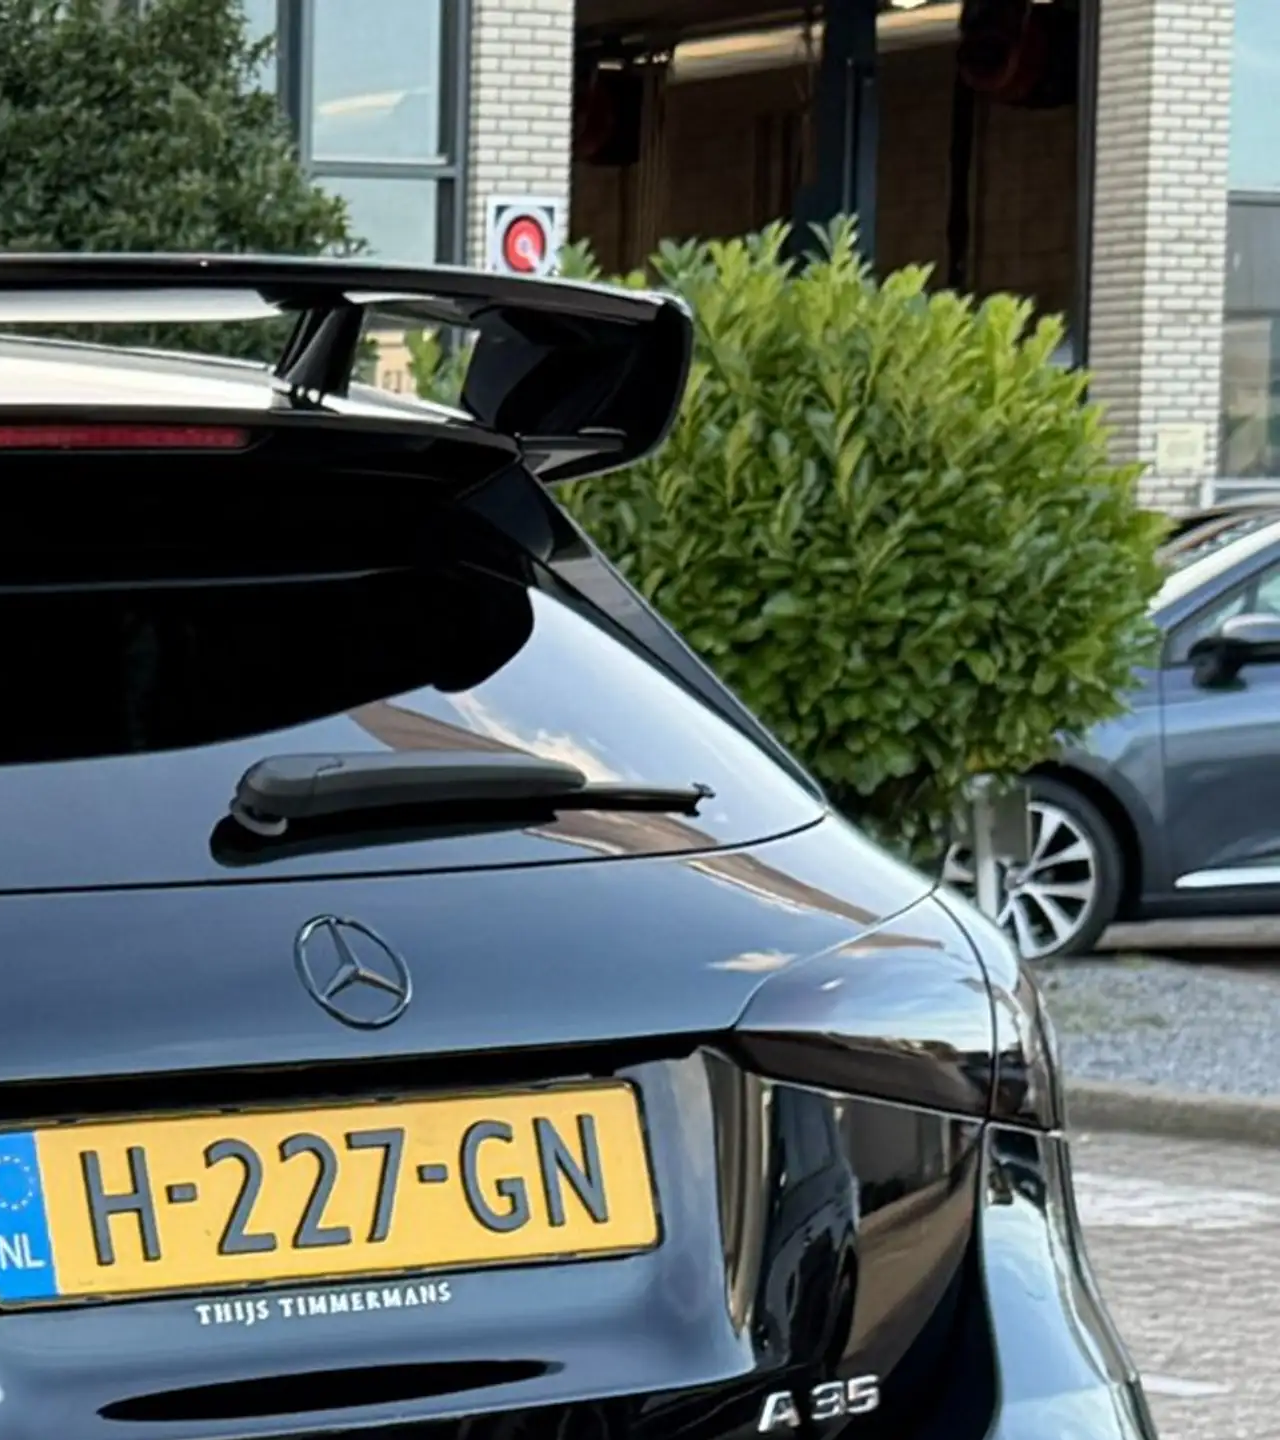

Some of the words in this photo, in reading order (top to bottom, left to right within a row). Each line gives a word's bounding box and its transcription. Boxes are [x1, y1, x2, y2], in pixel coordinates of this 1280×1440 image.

[79, 1113, 610, 1267] H-227-GN
[194, 1299, 270, 1327] THIJS
[278, 1281, 452, 1319] TIMMERMANS
[757, 1390, 801, 1432] A
[811, 1374, 879, 1420] 35
